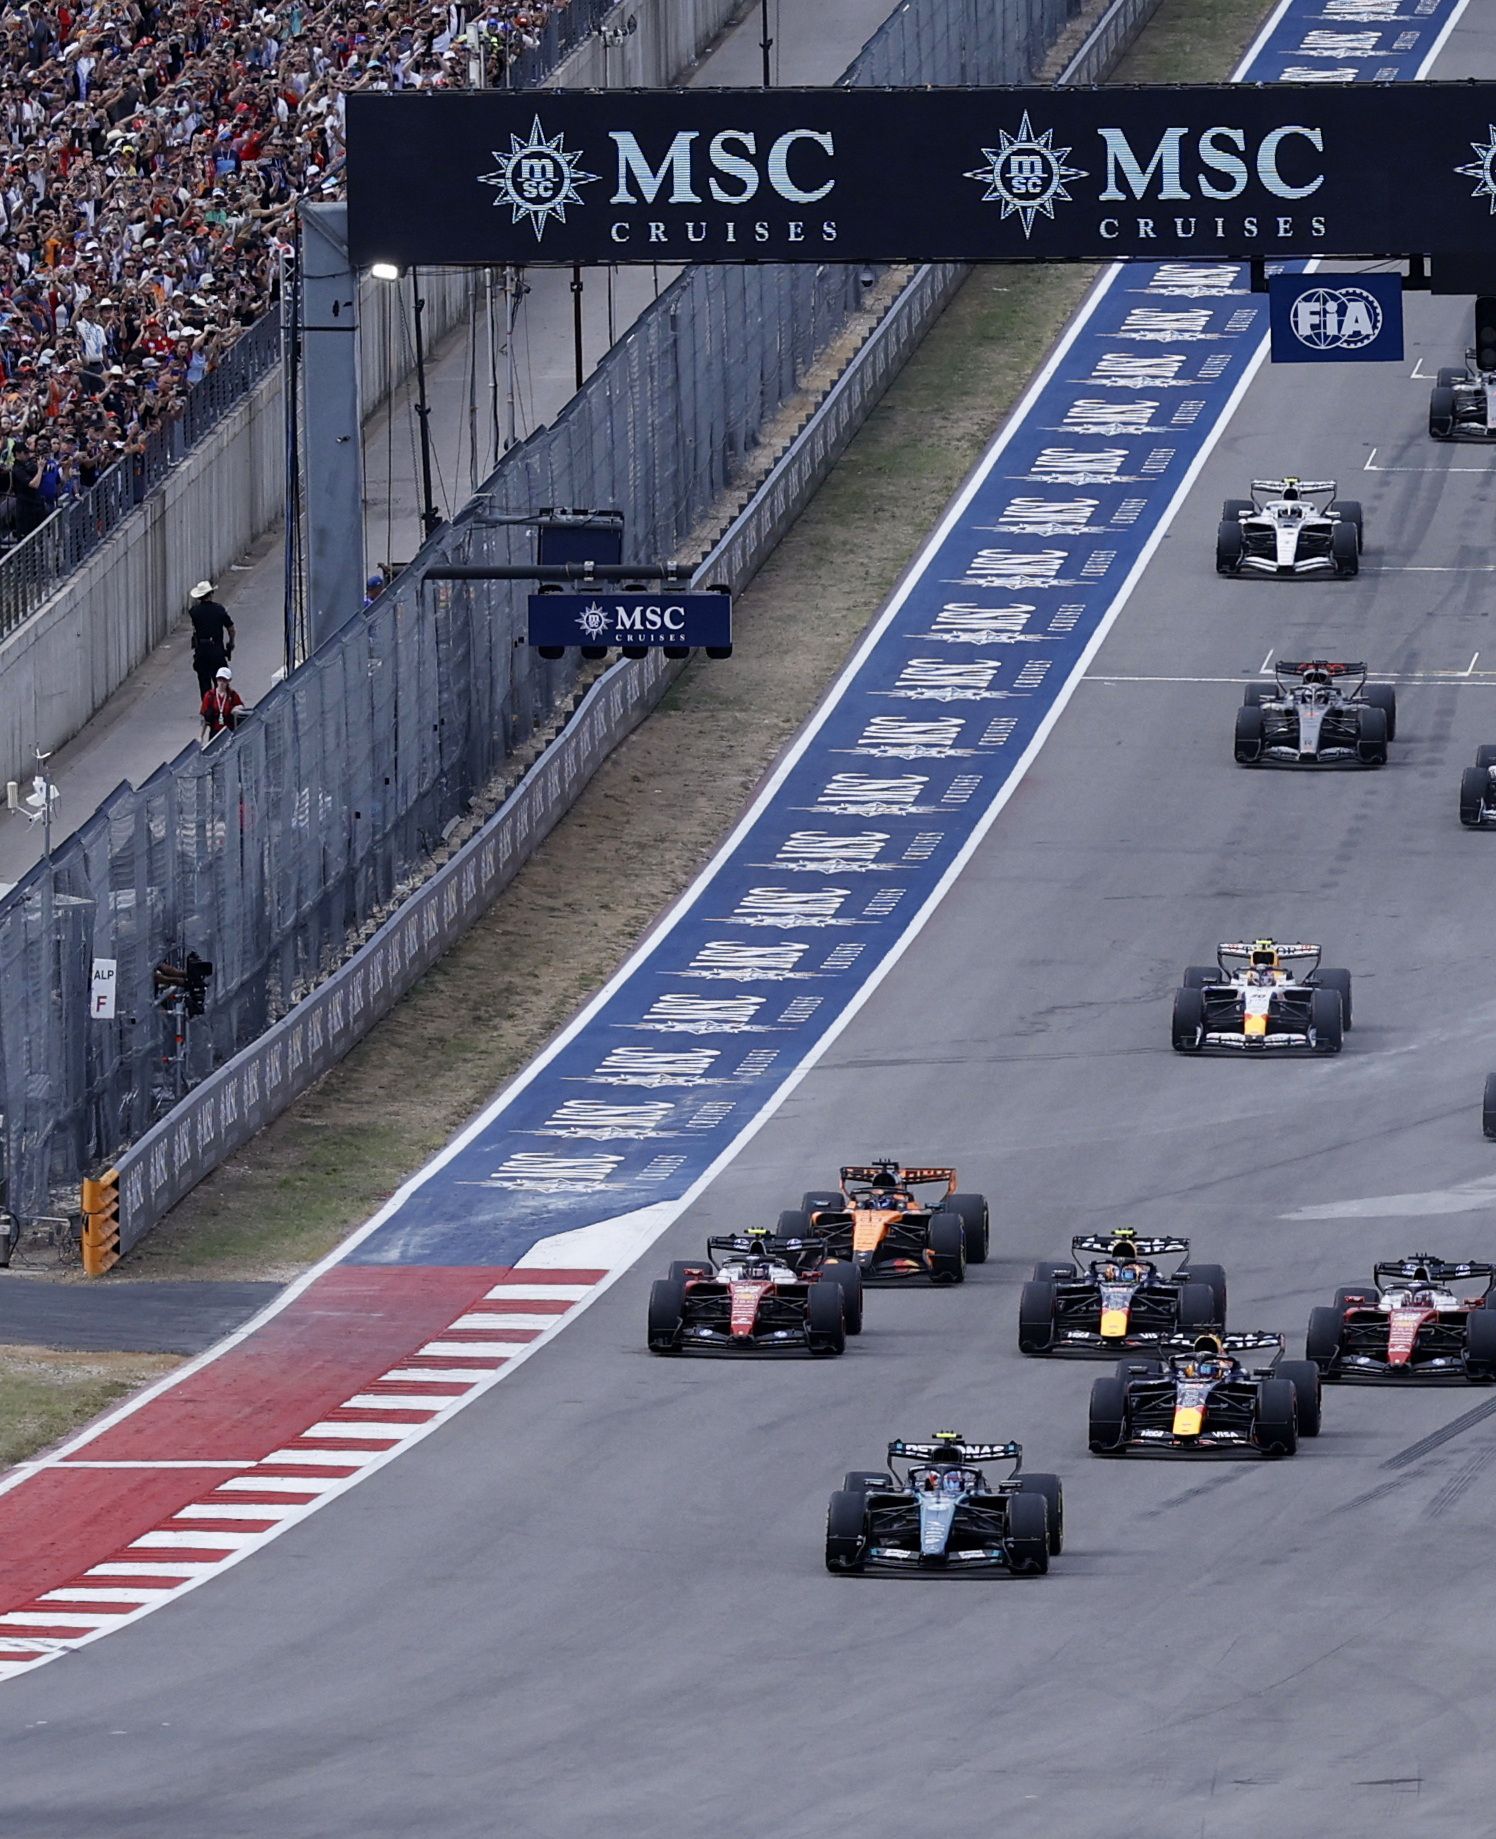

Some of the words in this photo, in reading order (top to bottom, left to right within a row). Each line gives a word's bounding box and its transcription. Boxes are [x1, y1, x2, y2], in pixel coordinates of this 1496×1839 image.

[609, 129, 836, 204] MSC
[1097, 125, 1325, 201] MSC
[611, 221, 837, 242] CRUISES
[1100, 216, 1326, 238] CRUISES
[616, 606, 685, 629] MSC
[94, 970, 115, 980] ALP
[96, 996, 107, 1012] F
[906, 1444, 1005, 1458] PETNAS
